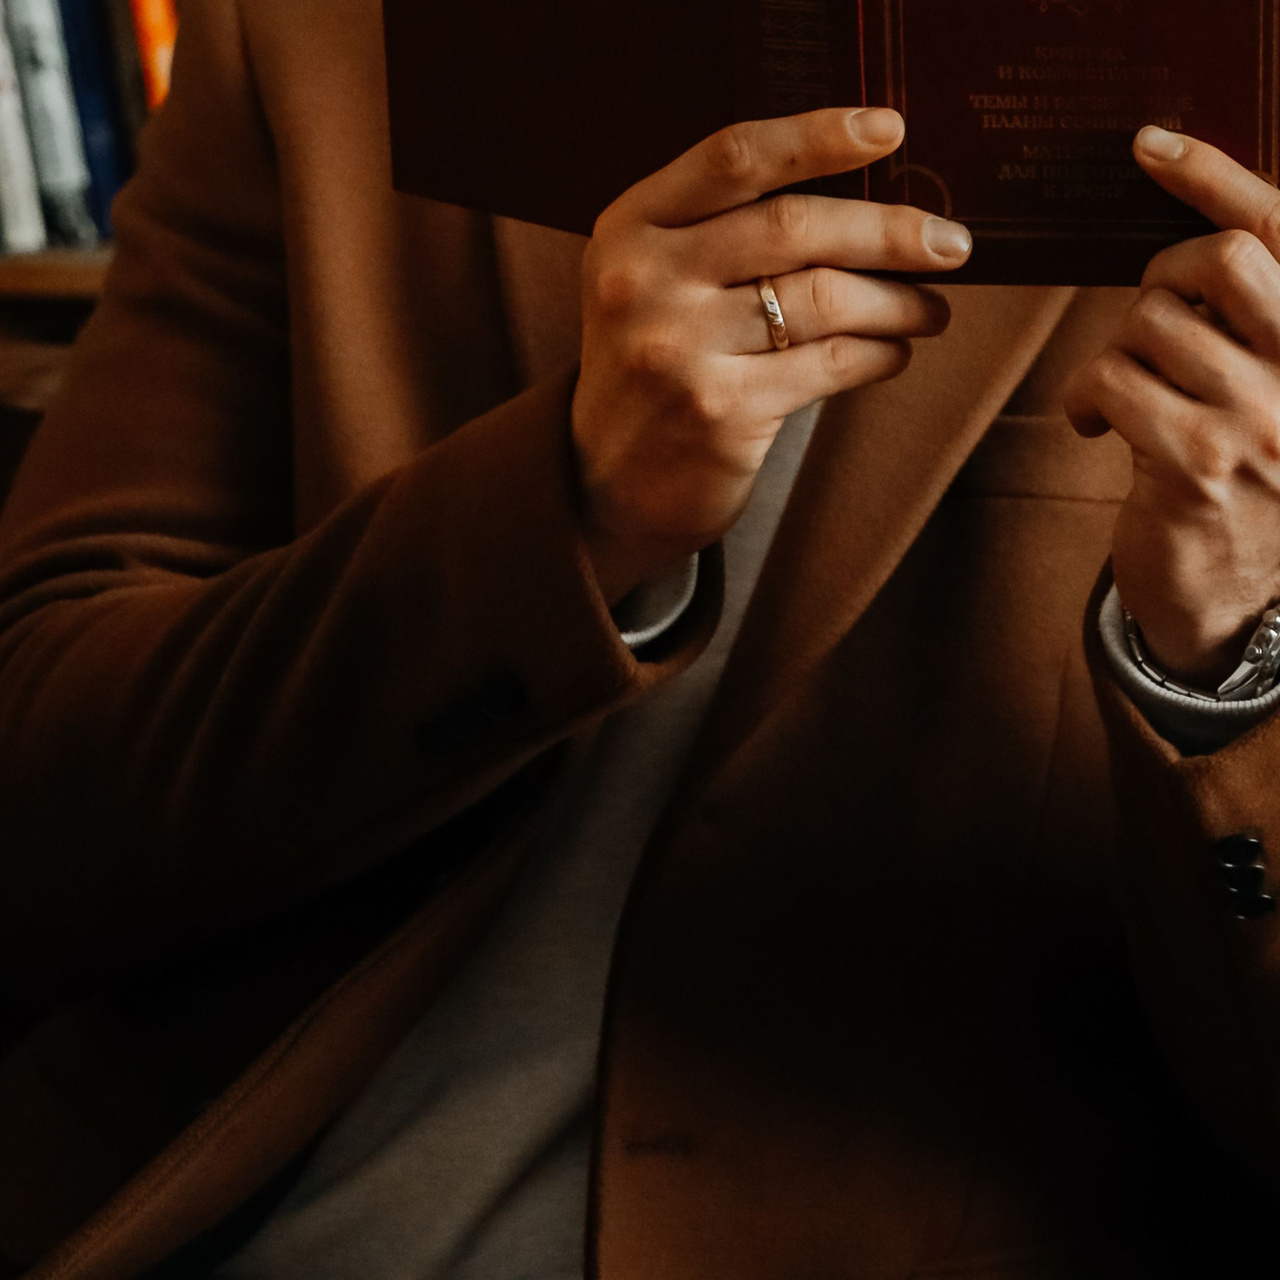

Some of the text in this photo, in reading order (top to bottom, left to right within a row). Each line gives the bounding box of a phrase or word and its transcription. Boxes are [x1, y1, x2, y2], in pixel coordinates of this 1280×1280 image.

[998, 65, 1013, 80] И
[969, 94, 1194, 111] ТЕМЫ И РАВЕТЫЕ
[982, 112, 1182, 130] ПЛАНЫ СОЧИНИЙ
[1022, 145, 1132, 160] МАТЕРИАЛ
[997, 164, 1036, 180] ДЛЯ
